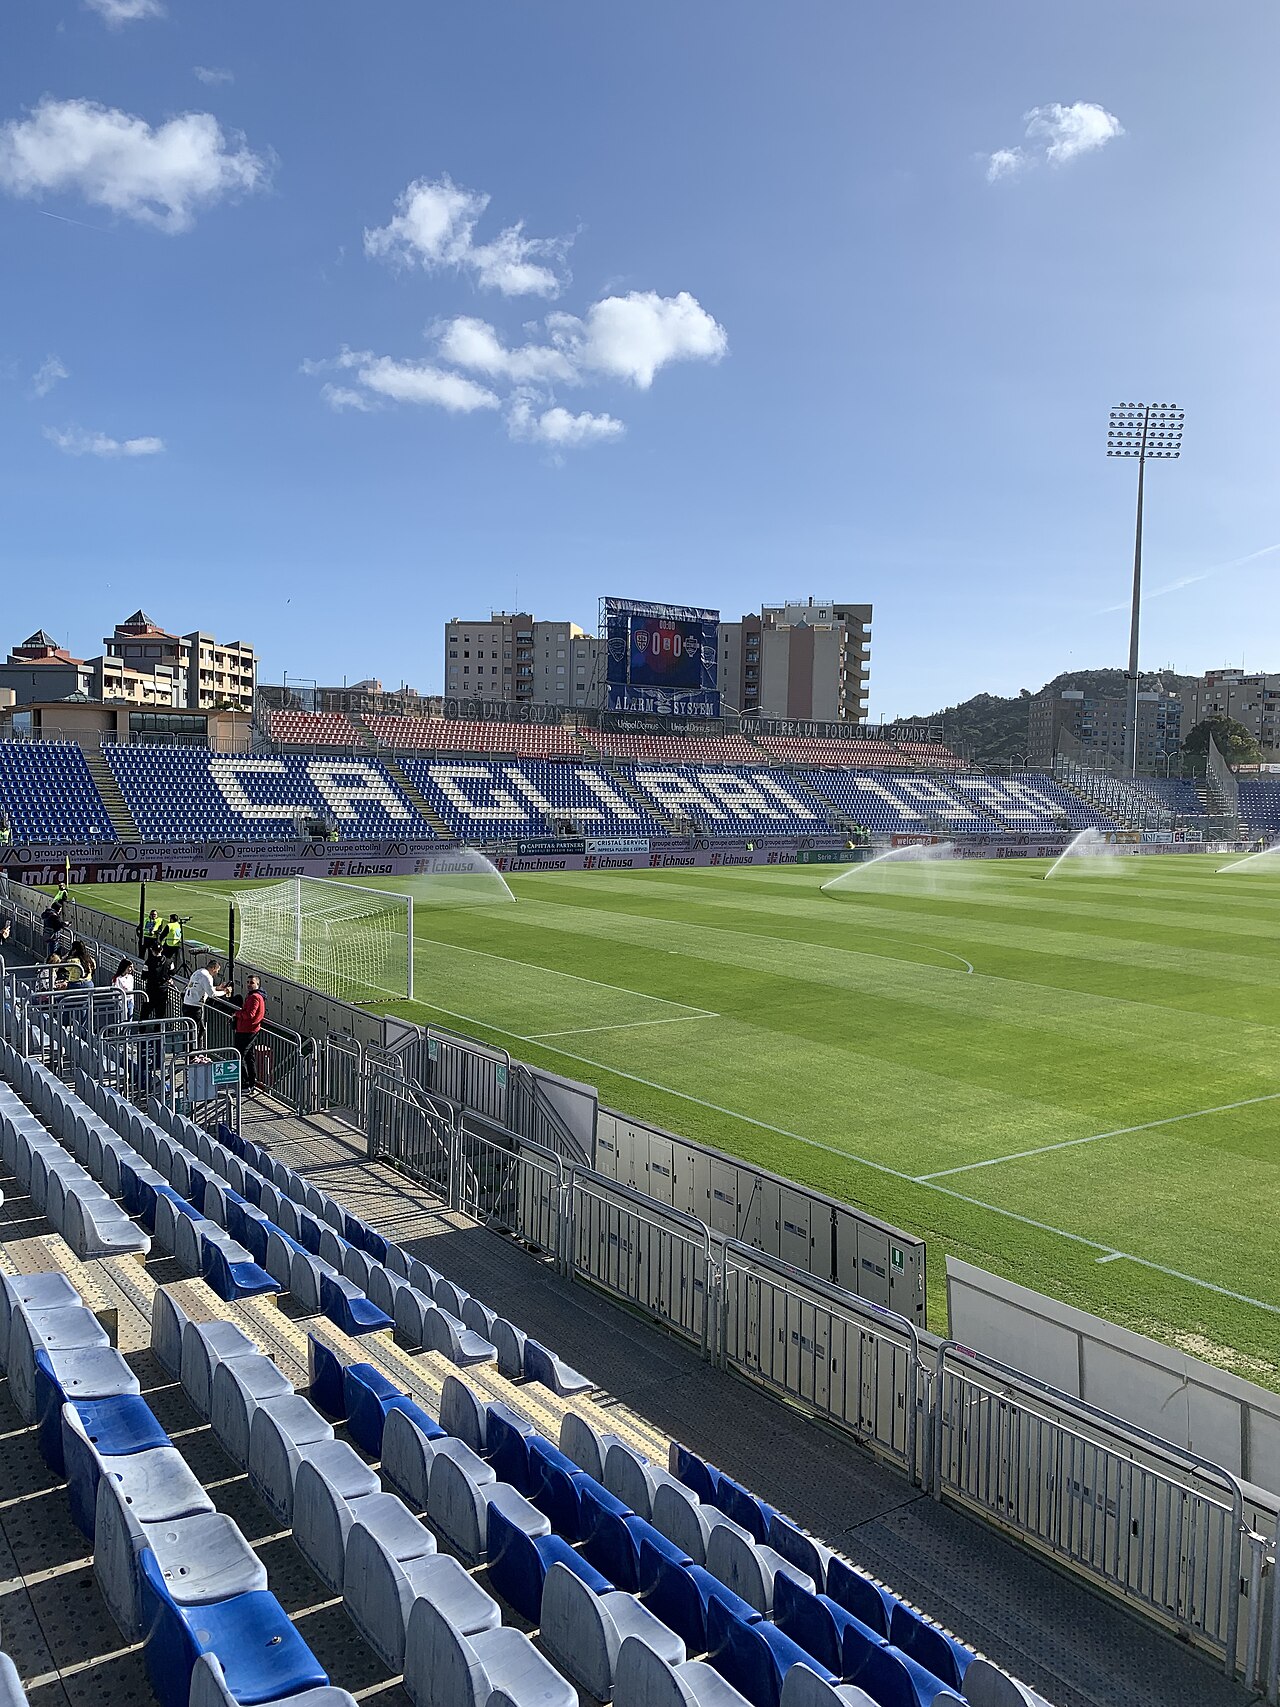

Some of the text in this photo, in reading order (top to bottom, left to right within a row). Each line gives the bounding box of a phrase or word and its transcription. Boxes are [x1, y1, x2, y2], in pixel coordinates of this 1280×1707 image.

[652, 632, 682, 657] 0 0
[482, 702, 512, 721] UNA
[615, 696, 714, 716] ALARM SYSTEM
[739, 719, 761, 734] UNA
[804, 723, 818, 738] UN
[866, 726, 885, 742] UNA
[34, 849, 68, 858] groupe
[140, 847, 203, 857] groupe ottolini
[237, 845, 296, 855] groupe ottolini
[327, 843, 381, 853] groupe ottolini
[410, 843, 434, 852] groupe
[1005, 846, 1027, 857] ichnusa
[432, 858, 474, 873] ichnusa
[510, 858, 566, 871] ichnchnusa
[598, 856, 633, 869] ichnusa
[663, 854, 695, 866] ichnusa
[723, 853, 753, 866] ichnusa
[254, 862, 304, 878] ichnusa
[346, 861, 393, 875] ichnusa
